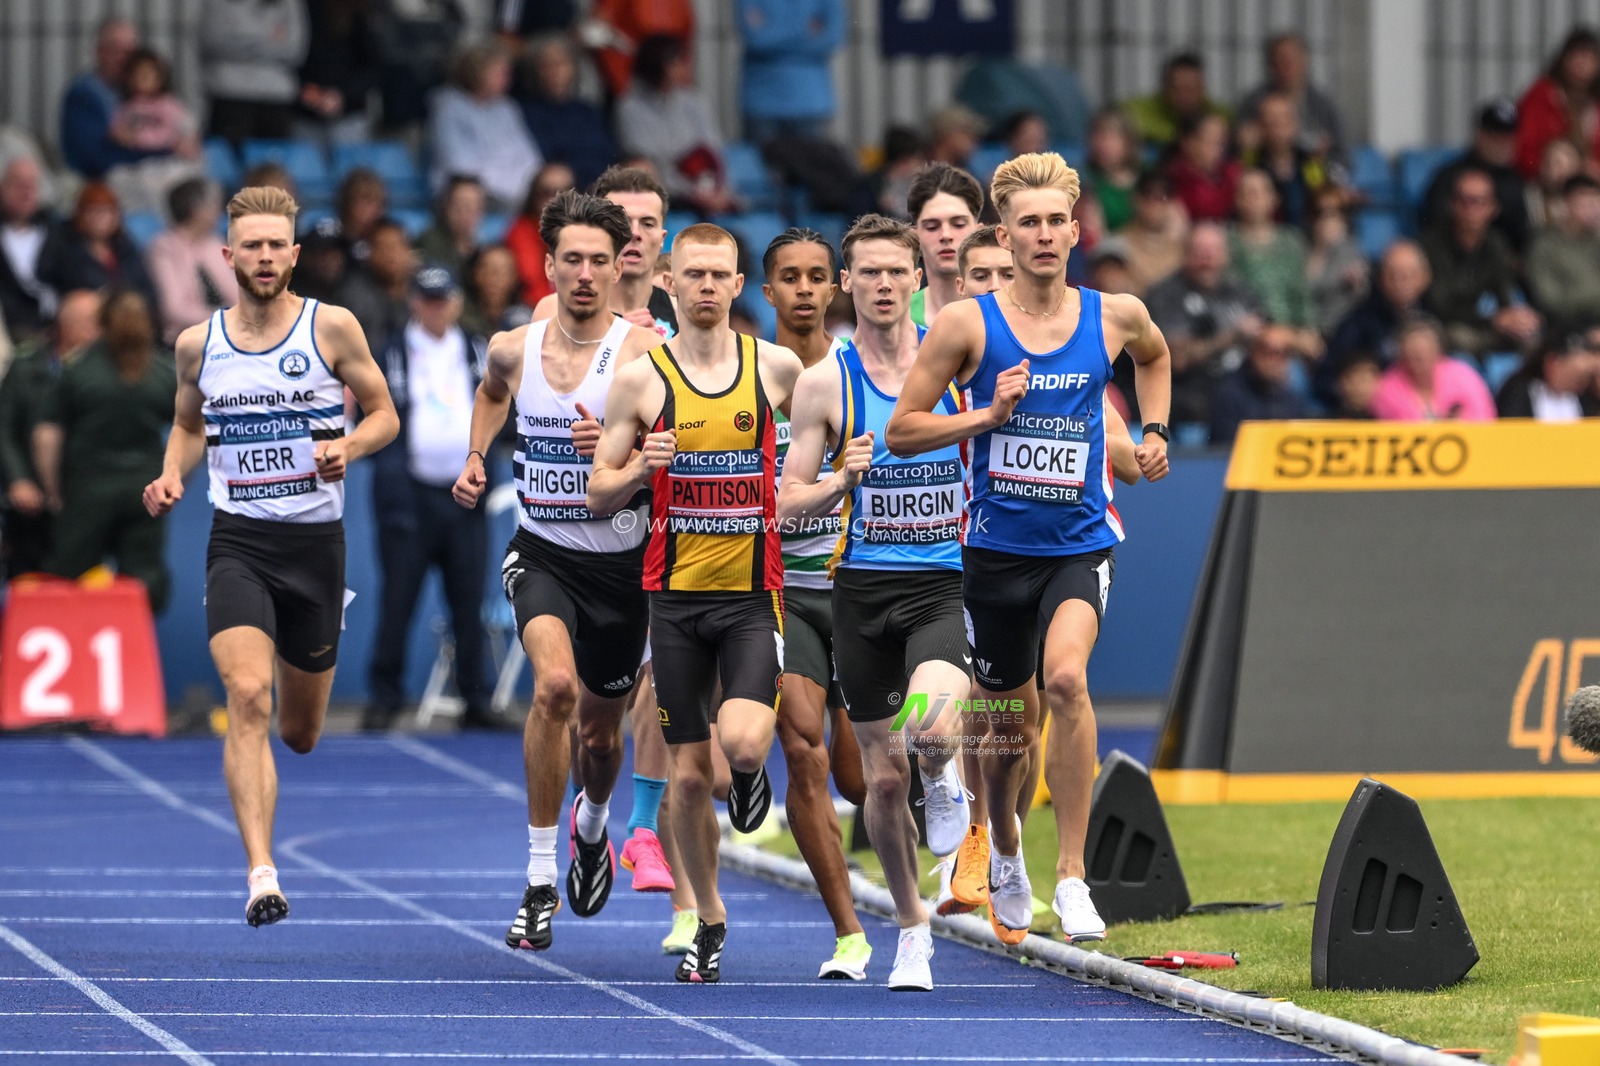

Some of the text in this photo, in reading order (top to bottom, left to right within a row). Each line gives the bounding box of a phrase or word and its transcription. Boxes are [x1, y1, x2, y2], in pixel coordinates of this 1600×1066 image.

[597, 347, 612, 375] soar
[1024, 373, 1090, 390] RDIFF
[209, 390, 315, 408] Edinburgh AC
[524, 415, 584, 429] TONBRID
[678, 420, 707, 430] soar
[1016, 427, 1056, 437] PROCESSING
[1064, 432, 1084, 440] TIMING
[237, 447, 296, 474] KERR
[1003, 442, 1077, 474] LOCKE
[1274, 433, 1470, 479] SEIKO
[529, 468, 590, 495] HIGGIN
[933, 475, 955, 483] TIMING
[1003, 473, 1034, 482] ATHLETICS
[233, 480, 311, 499] MANCHESTER
[672, 479, 760, 506] PATTISON
[994, 480, 1078, 501] MANCHESTER
[529, 506, 593, 519] MANCHES
[871, 489, 954, 518] BURGIN
[675, 518, 759, 531] MANCHESTER
[870, 526, 958, 542] MANCHESTER
[17, 625, 124, 718] 21
